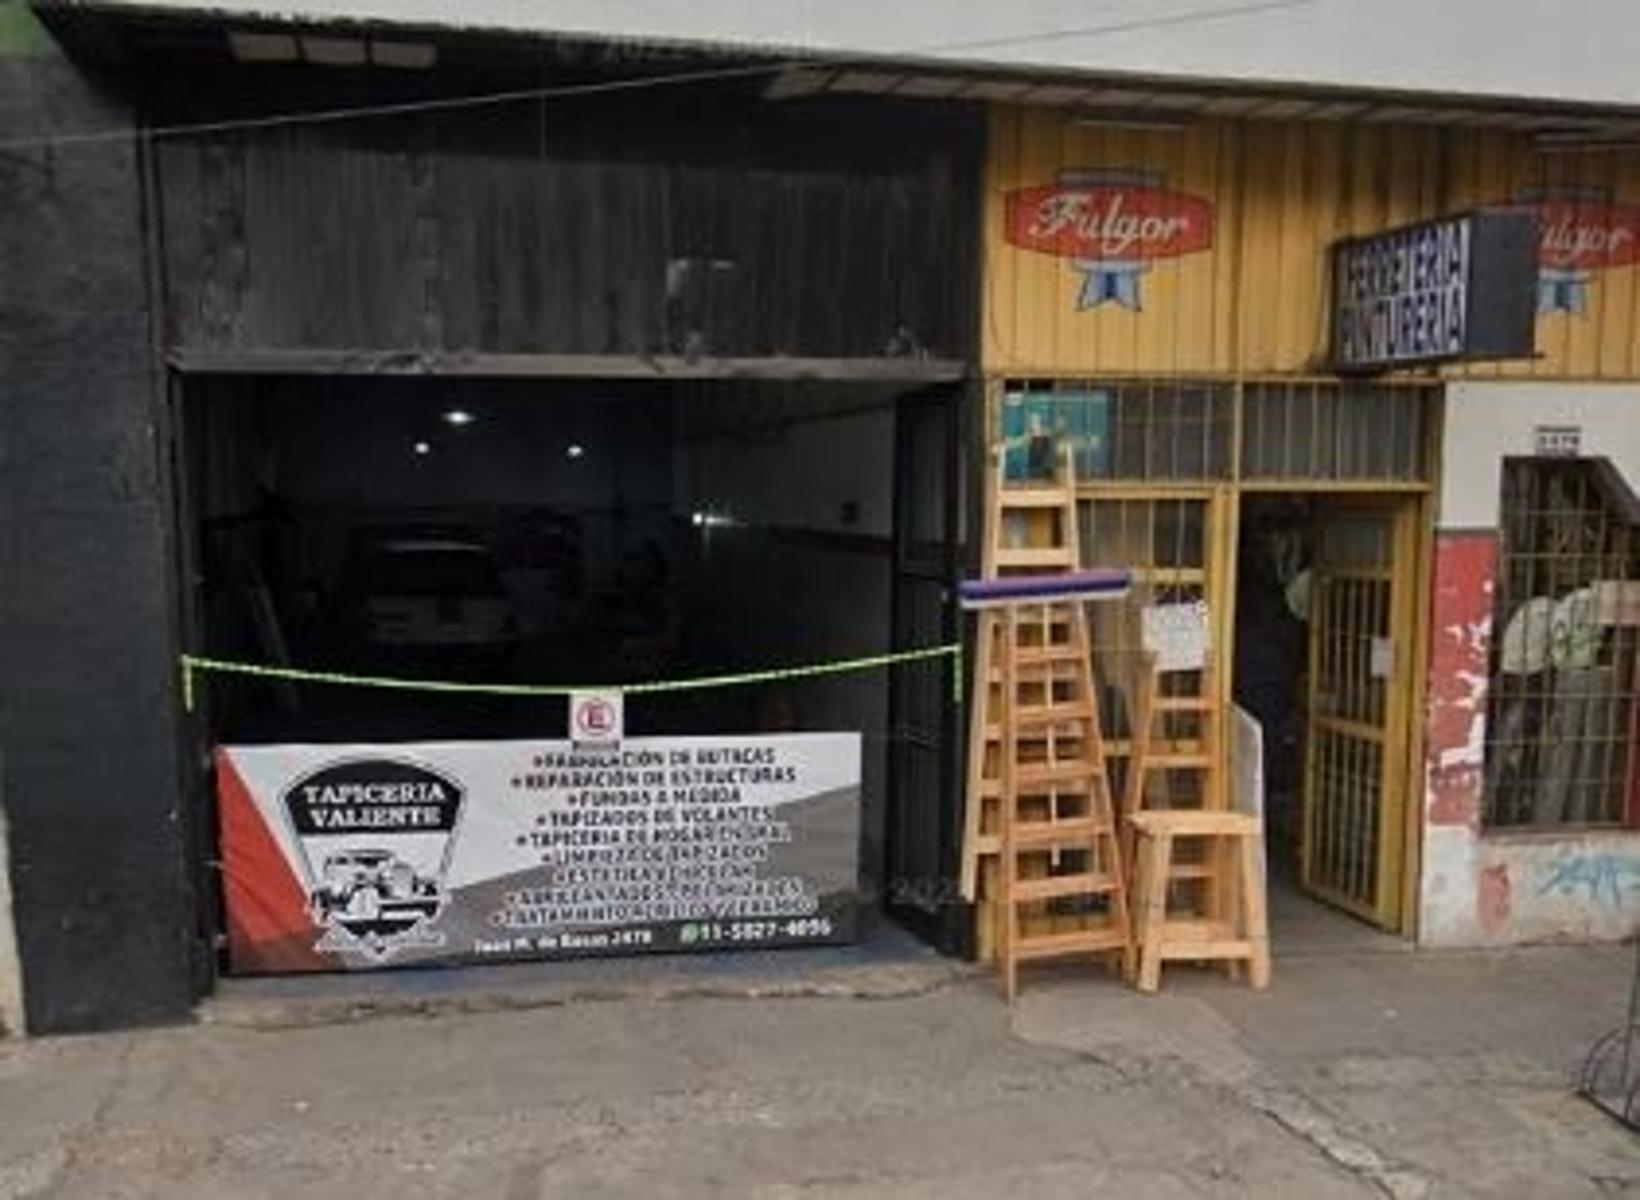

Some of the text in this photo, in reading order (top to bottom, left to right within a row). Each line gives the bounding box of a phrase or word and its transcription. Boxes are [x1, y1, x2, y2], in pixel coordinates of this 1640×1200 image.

[1028, 193, 1188, 256] Fulgor
[304, 782, 445, 804] TAPICERIA
[309, 806, 442, 828] VALIENTE
